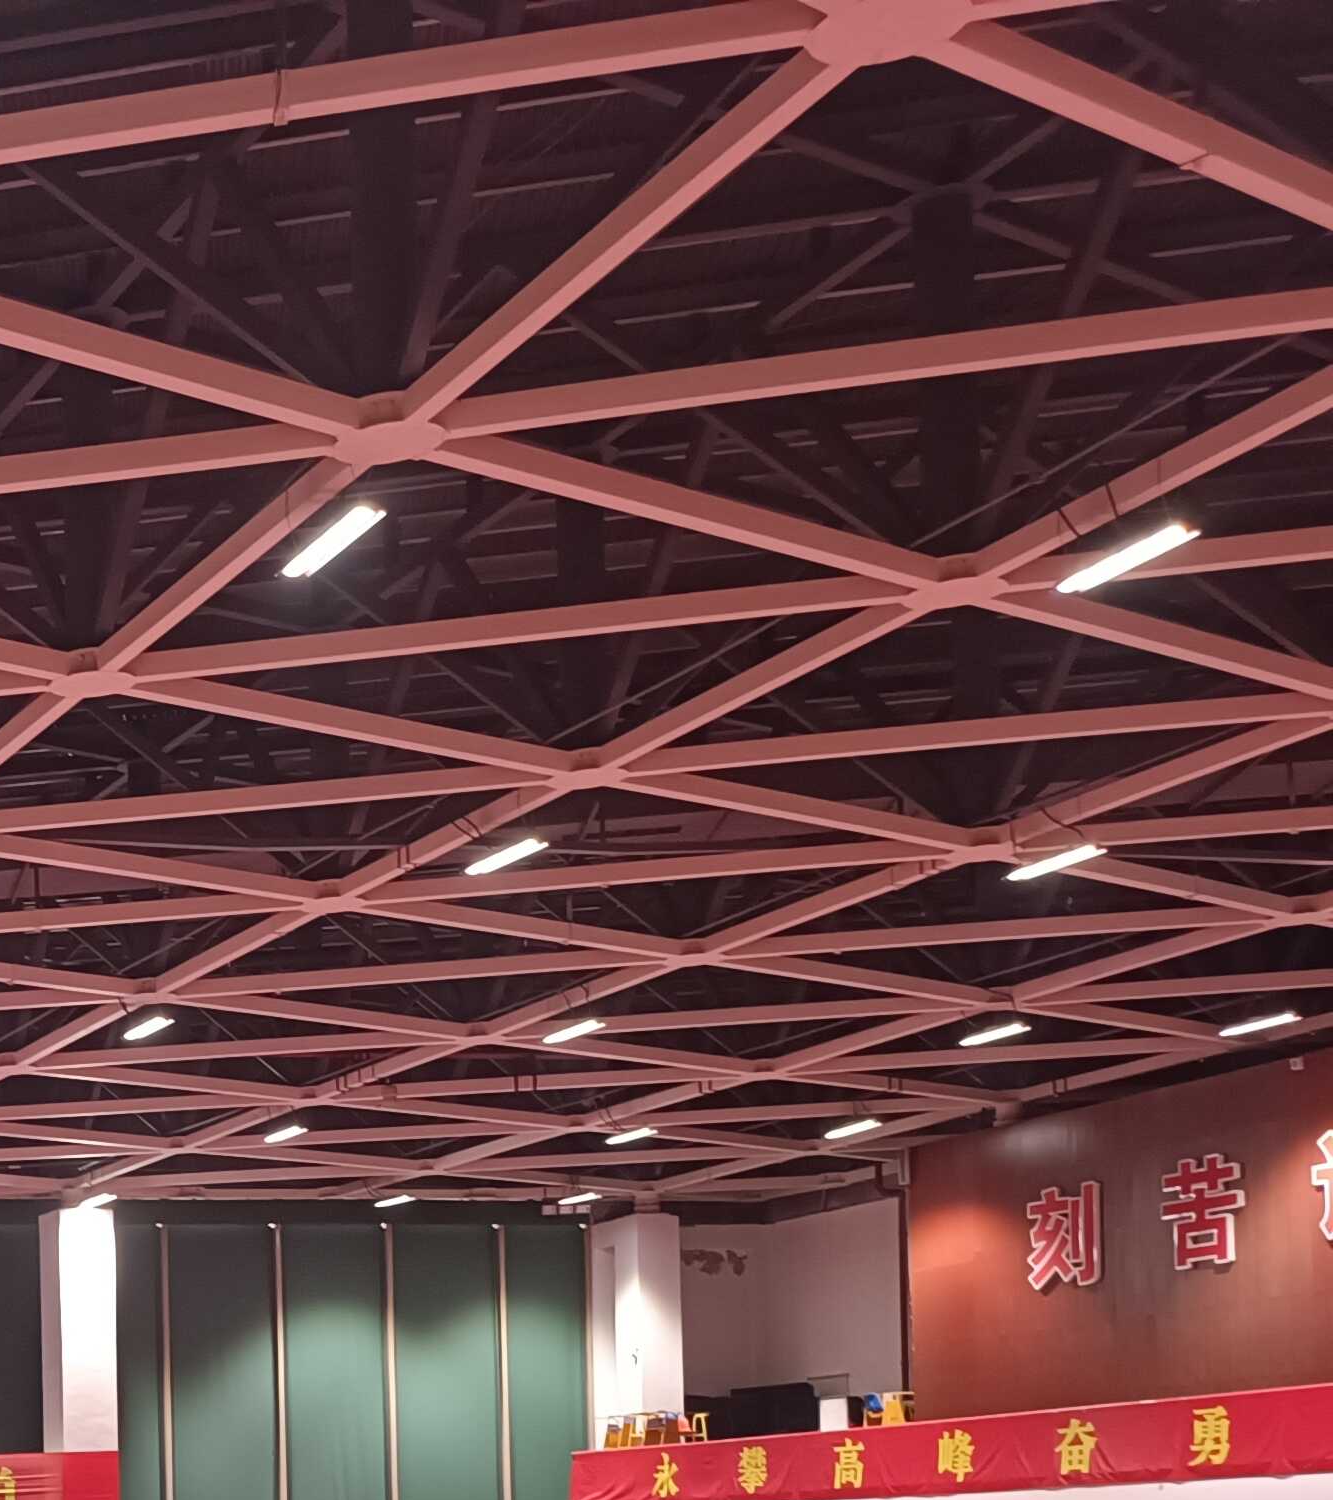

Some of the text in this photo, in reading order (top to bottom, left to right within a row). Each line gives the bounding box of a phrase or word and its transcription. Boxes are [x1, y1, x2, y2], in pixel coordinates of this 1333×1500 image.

[652, 1404, 1230, 1499] 永攀高峰奋勇
